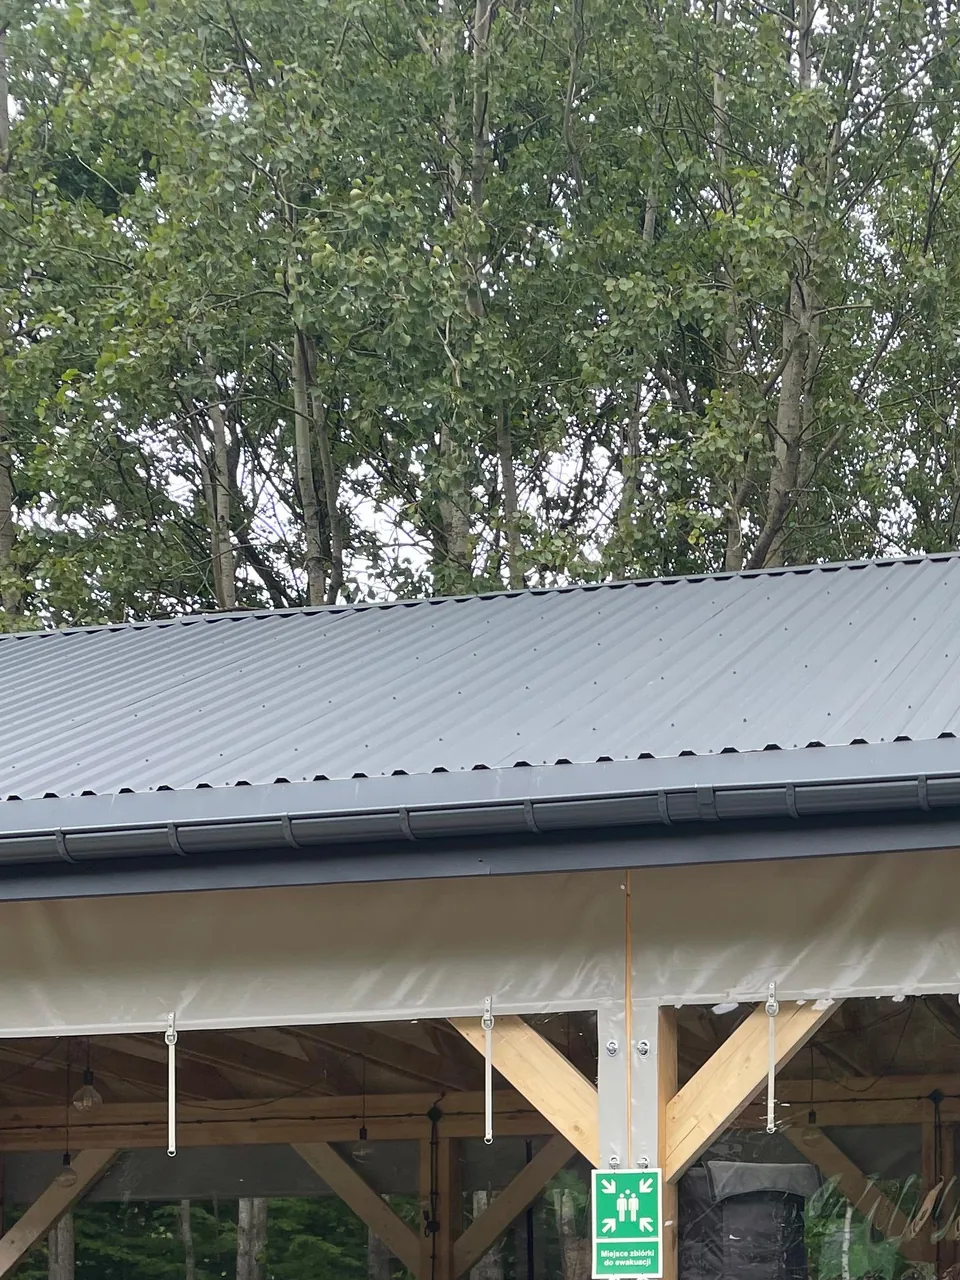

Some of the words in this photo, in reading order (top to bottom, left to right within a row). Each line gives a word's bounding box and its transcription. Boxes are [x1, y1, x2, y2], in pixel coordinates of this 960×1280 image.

[600, 1250, 628, 1258] Miejsce
[630, 1249, 655, 1257] zbiórki
[615, 1258, 651, 1267] ewakuacji
